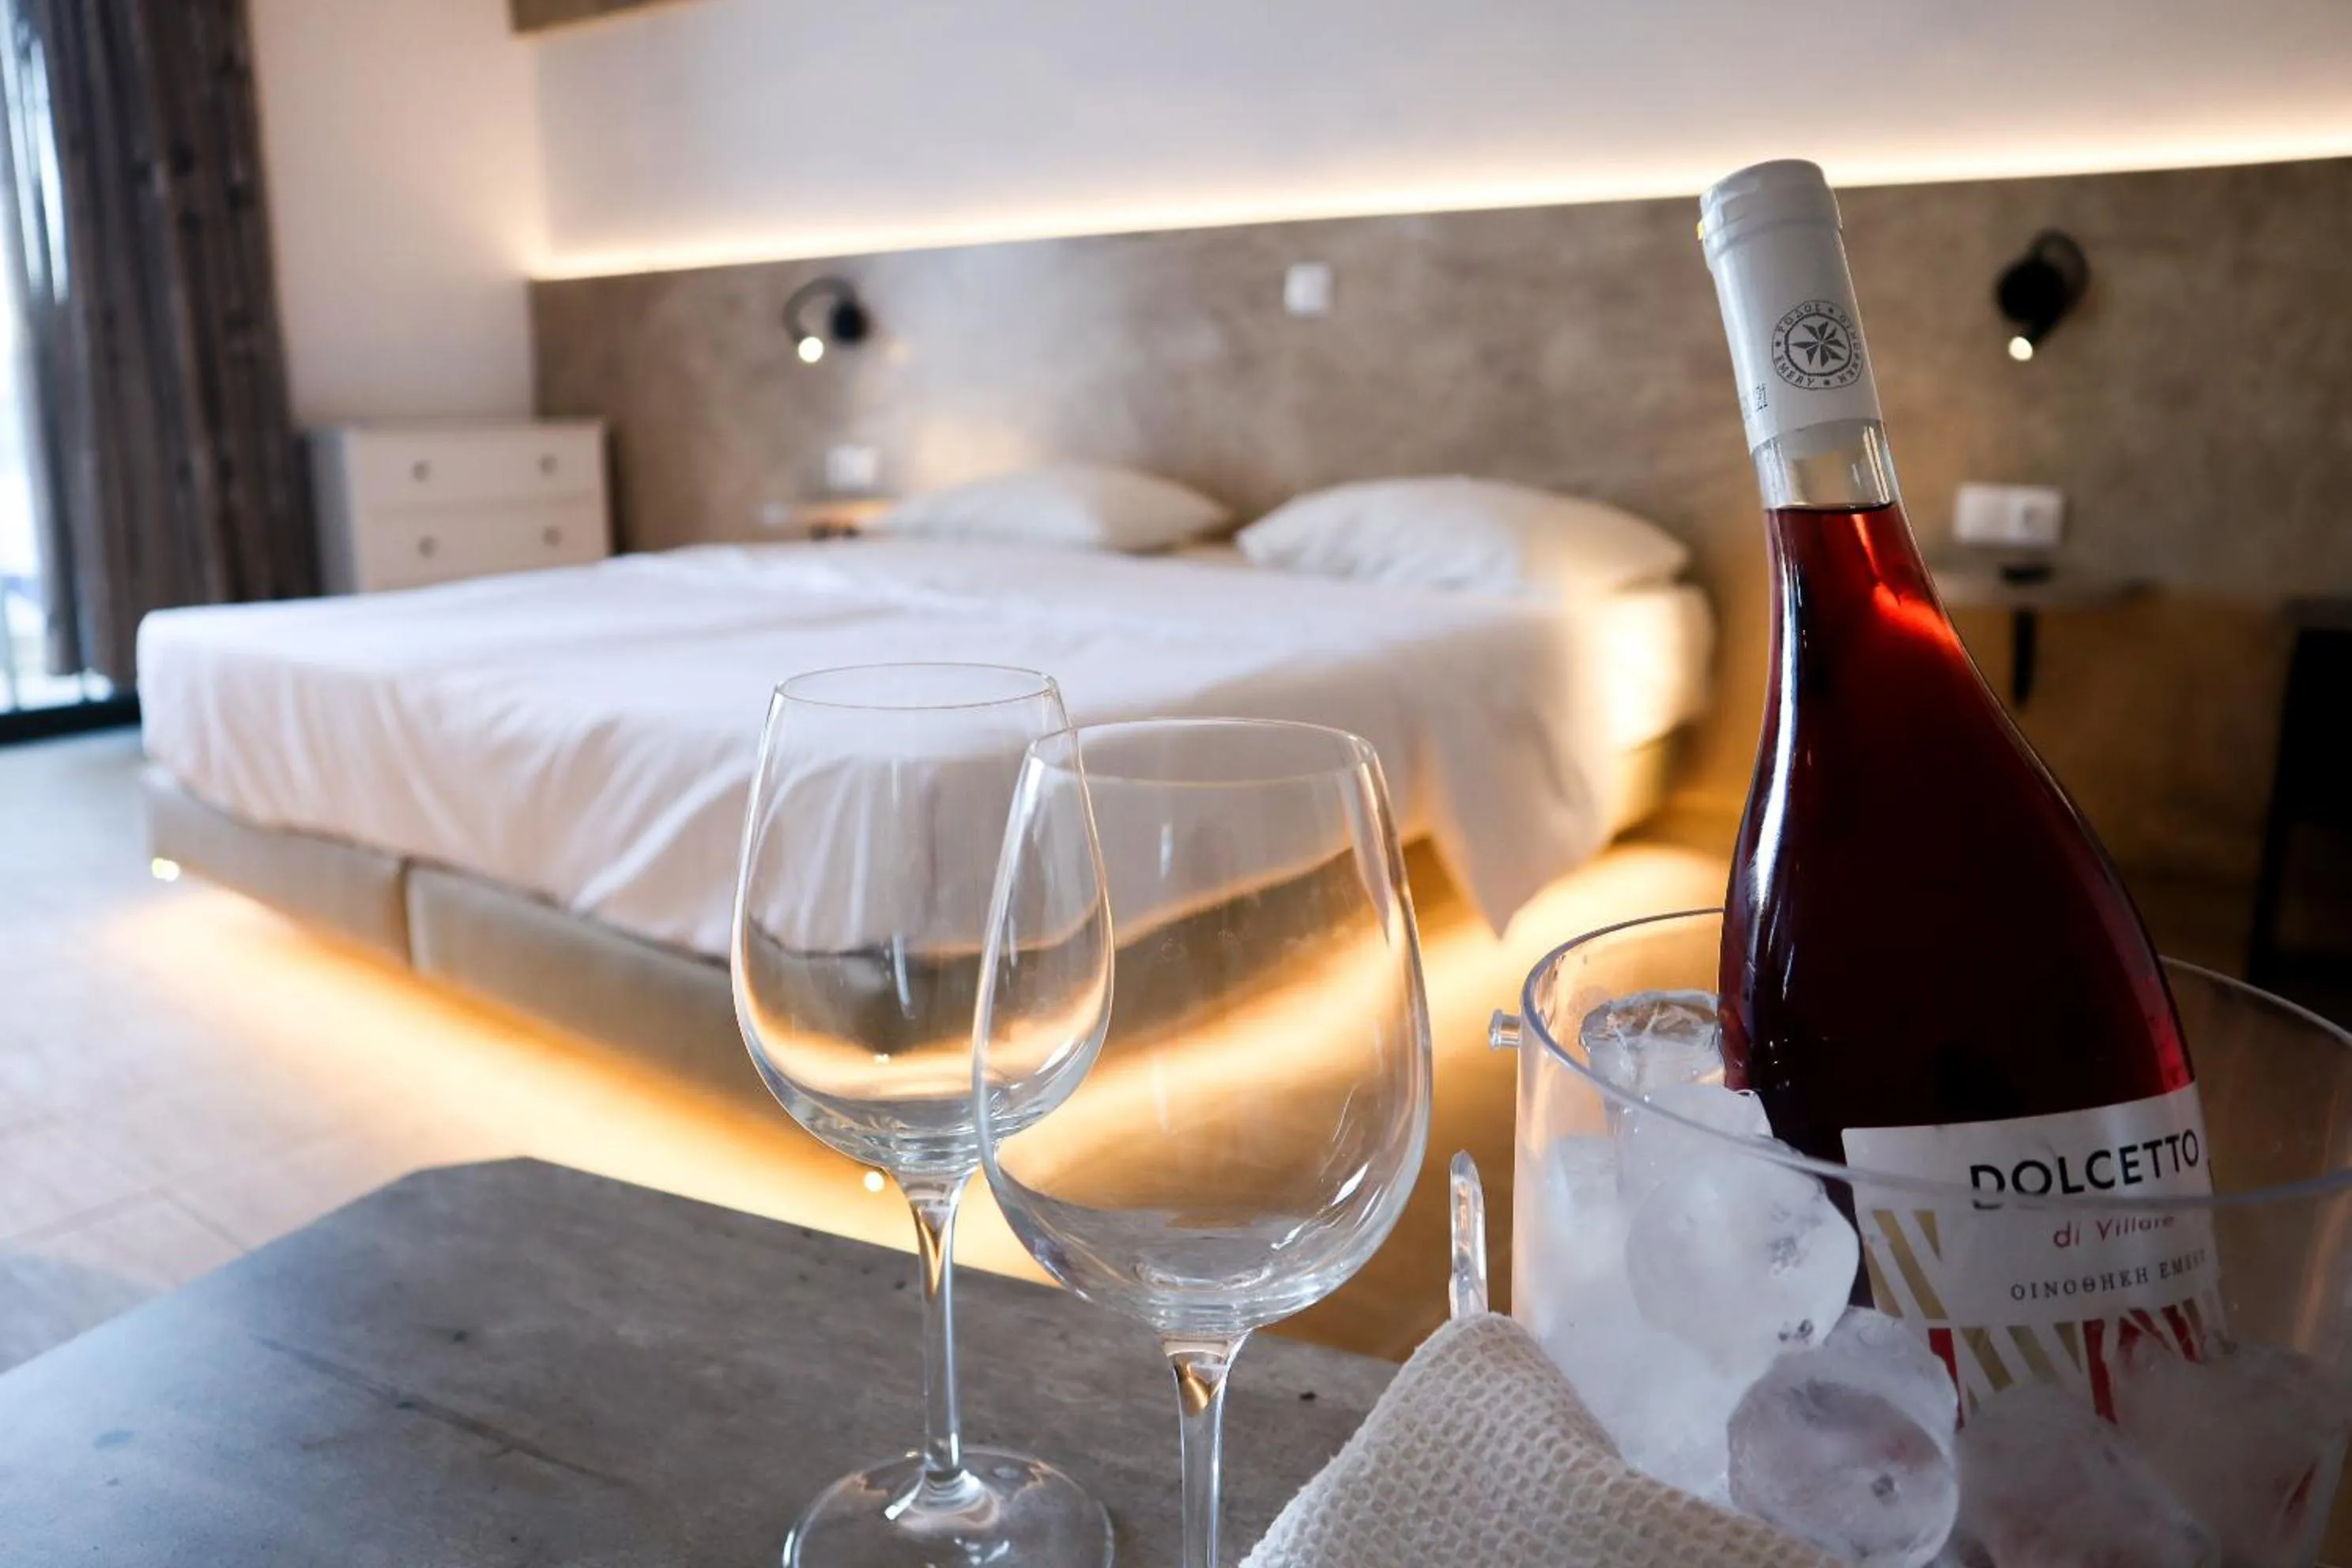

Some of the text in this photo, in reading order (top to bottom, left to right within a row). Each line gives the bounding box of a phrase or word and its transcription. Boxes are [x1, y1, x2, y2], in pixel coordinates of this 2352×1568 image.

[1969, 1129, 2199, 1210] DOLCETTO
[2053, 1216, 2176, 1248] di Villare
